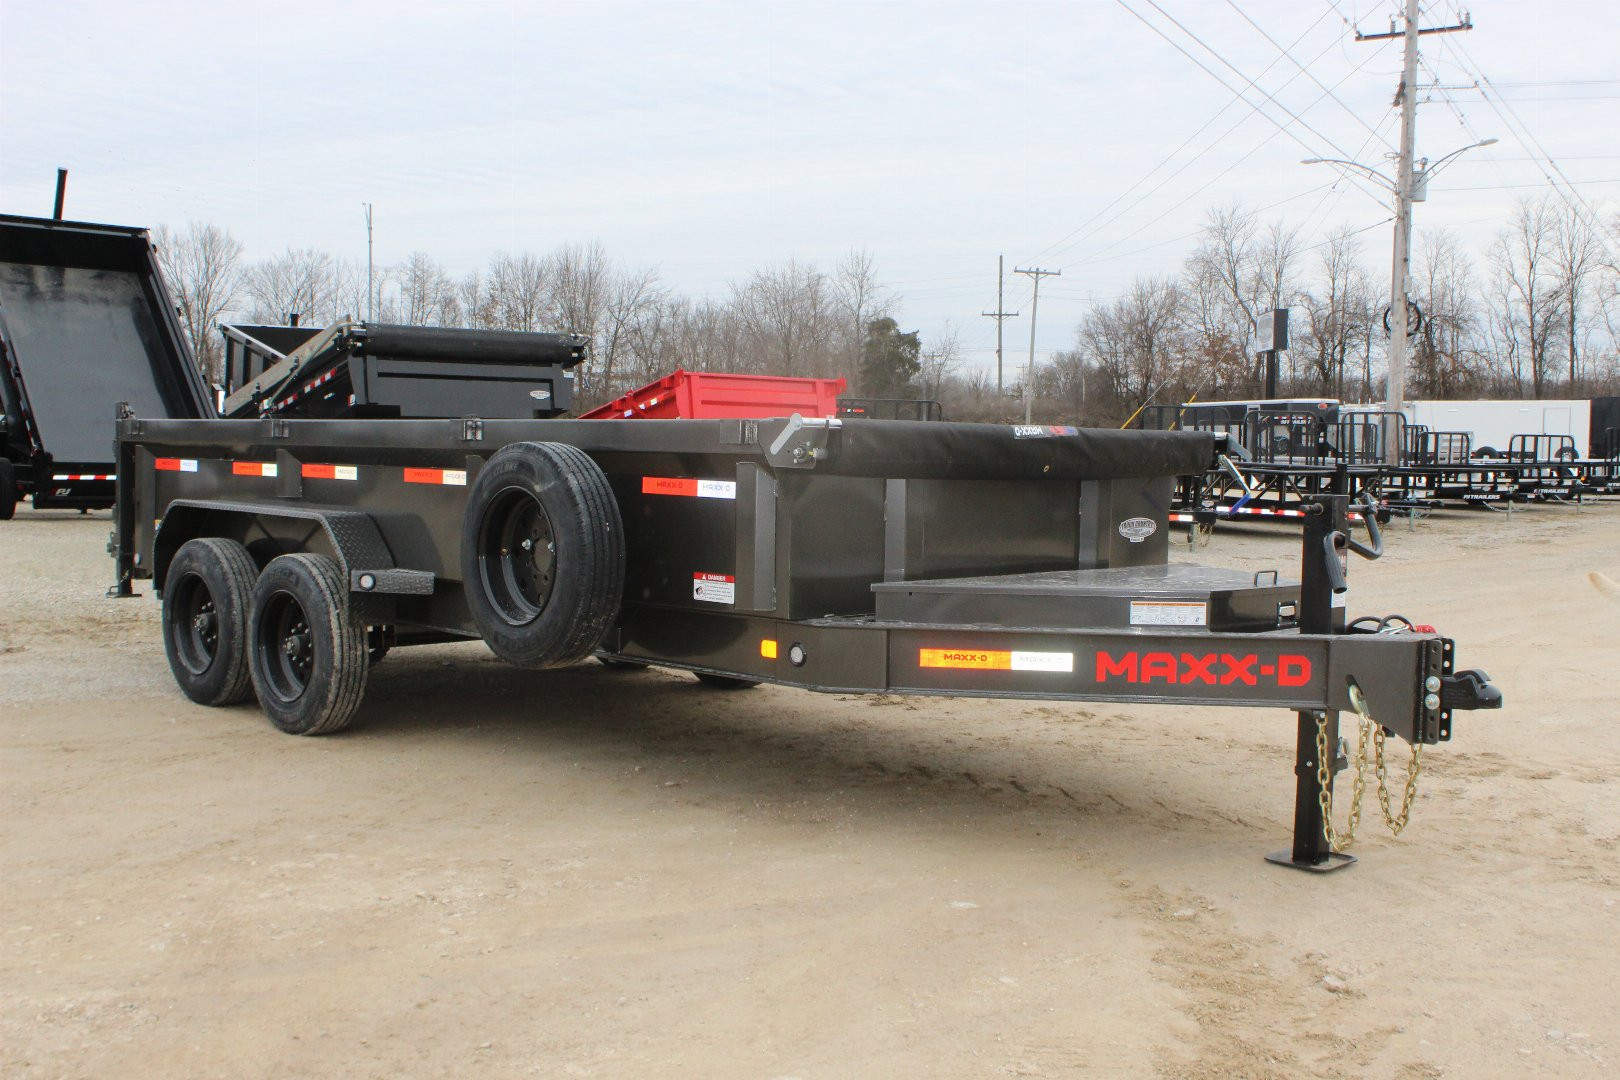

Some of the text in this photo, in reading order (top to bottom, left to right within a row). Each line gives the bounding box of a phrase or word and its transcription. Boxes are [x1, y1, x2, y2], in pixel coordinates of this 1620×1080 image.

[656, 480, 683, 489] MAXX-D
[702, 483, 731, 492] MAXX-D
[943, 653, 988, 662] MAXX-D
[1096, 651, 1312, 687] MAXX-D
